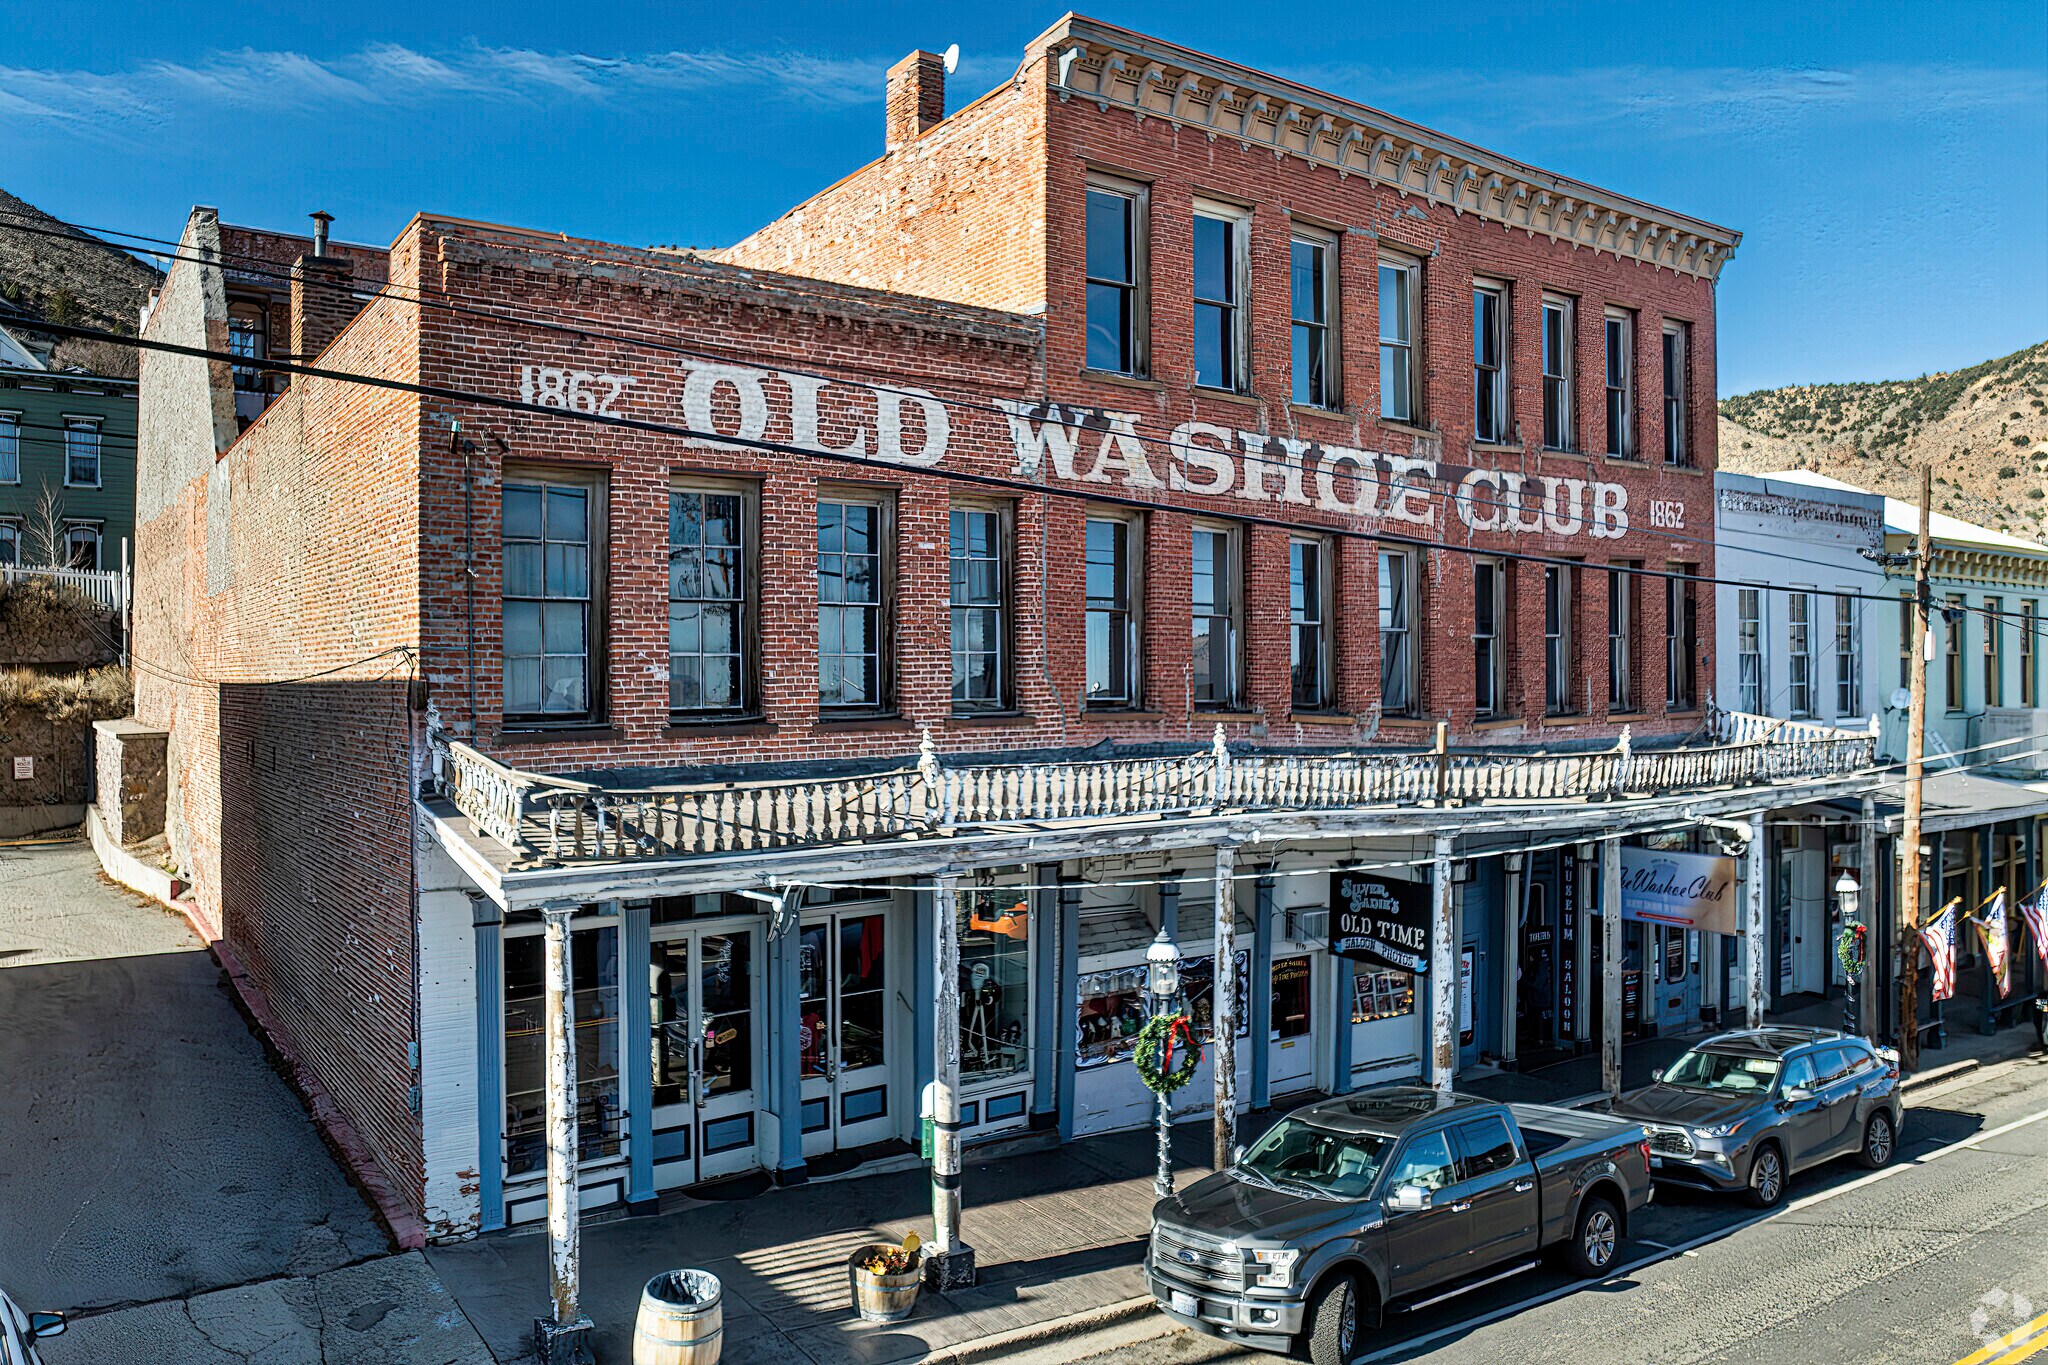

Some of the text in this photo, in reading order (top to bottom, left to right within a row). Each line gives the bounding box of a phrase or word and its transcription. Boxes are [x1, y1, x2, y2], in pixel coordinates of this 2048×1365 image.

[518, 359, 1629, 539] 1862 OLD WASHOE CLUB
[1650, 499, 1685, 529] 1862
[1633, 868, 1687, 898] Washoe
[1688, 875, 1728, 902] Club
[1341, 913, 1425, 950] OLD TIME
[1563, 855, 1574, 1032] MUSEUM SALOON
